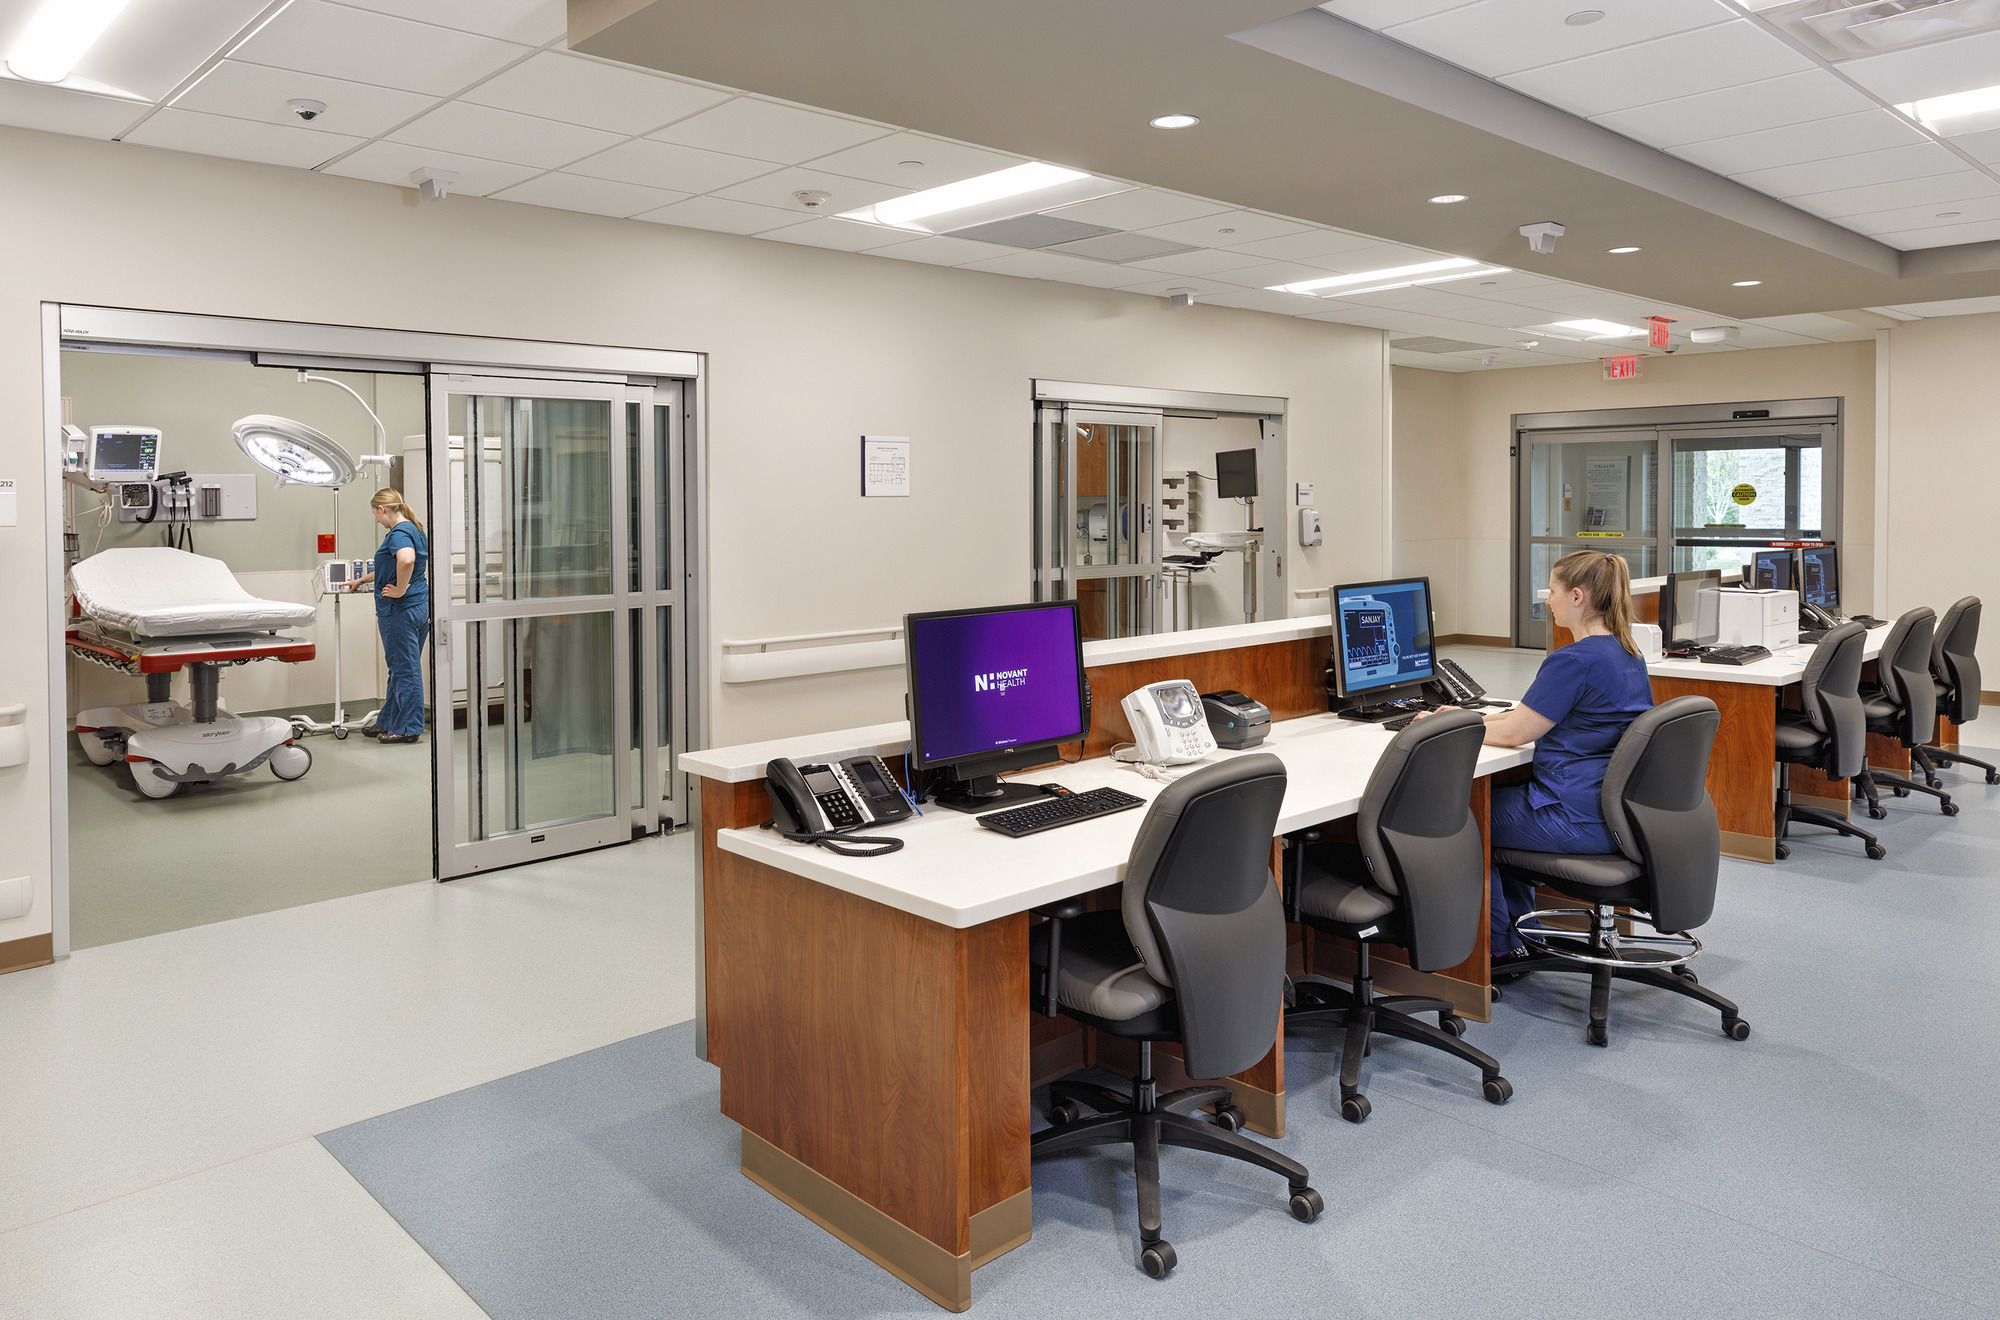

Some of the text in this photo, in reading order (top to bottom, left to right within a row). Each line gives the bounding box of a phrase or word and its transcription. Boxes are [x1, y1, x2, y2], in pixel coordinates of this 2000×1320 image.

[1652, 322, 1667, 347] EXIT
[1611, 358, 1637, 378] EXIT
[1361, 615, 1381, 624] SANJAY
[996, 668, 1028, 680] NOVANT
[996, 677, 1026, 689] HEALTH
[202, 729, 231, 738] stryker
